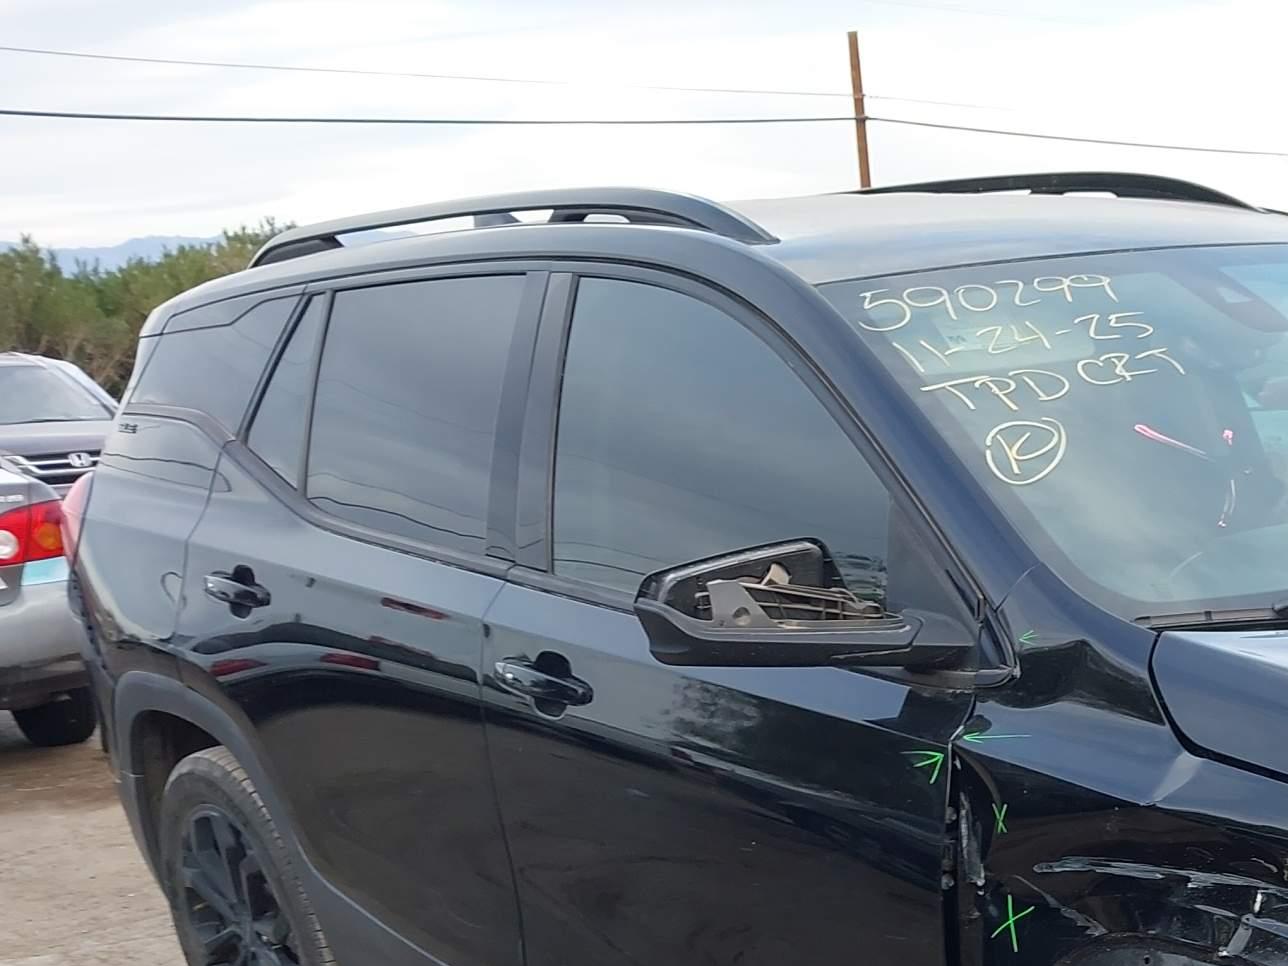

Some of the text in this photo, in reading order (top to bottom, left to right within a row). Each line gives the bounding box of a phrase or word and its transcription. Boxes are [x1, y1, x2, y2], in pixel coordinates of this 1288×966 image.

[859, 274, 1119, 331] 590299
[893, 311, 1154, 373] 11-24-25
[919, 368, 1071, 411] TPD
